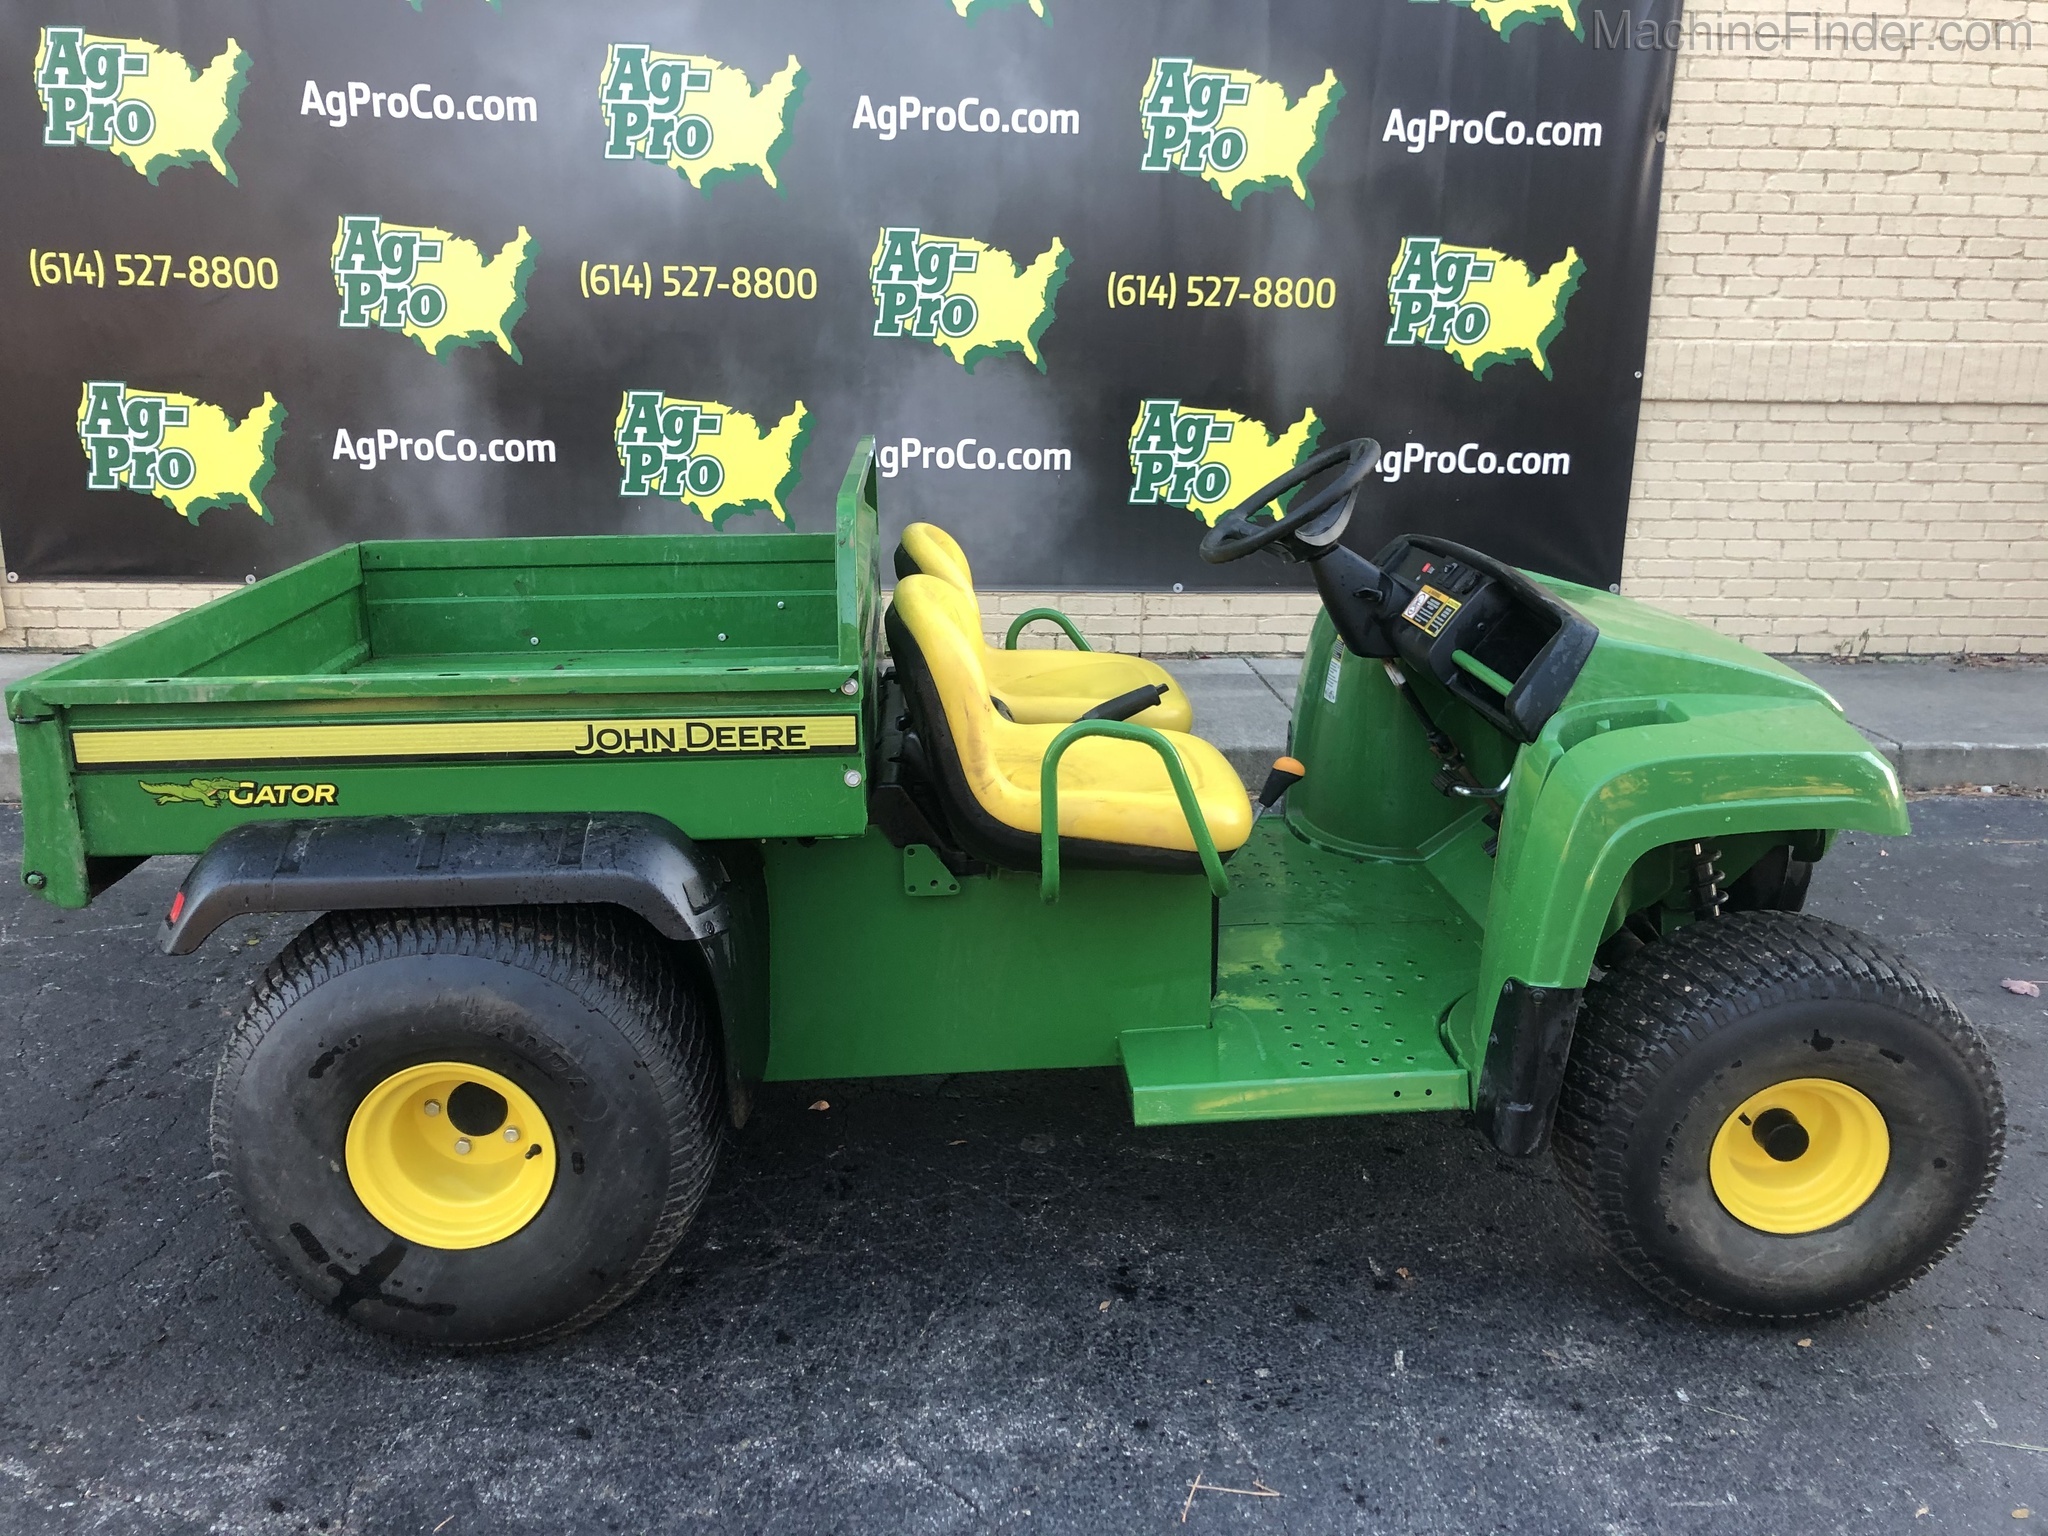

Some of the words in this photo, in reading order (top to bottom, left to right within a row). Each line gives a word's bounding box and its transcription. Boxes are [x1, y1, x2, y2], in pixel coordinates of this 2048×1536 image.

[38, 27, 149, 99] Ag-
[603, 44, 711, 114] Ag-
[43, 86, 155, 145] Pro
[301, 80, 538, 128] AgProCo.com
[852, 95, 1080, 141] AgProCo.com
[1143, 58, 1249, 127] Ag-
[604, 102, 713, 160] Pro
[1141, 115, 1248, 171] Pro
[1382, 108, 1602, 153] AgProCo.com
[29, 248, 105, 289] (614)
[115, 253, 279, 290] 527-8800
[334, 214, 443, 287] Ag-
[875, 227, 979, 297] Ag-
[1391, 237, 1495, 304] Ag-
[339, 272, 447, 328] Pro
[580, 260, 652, 299] (614)
[662, 265, 818, 300] 527-8800
[1107, 271, 1177, 310] (614)
[1187, 276, 1337, 309] 527-8800
[873, 282, 979, 337] Pro
[1387, 293, 1490, 345] Pro
[82, 382, 189, 454] Ag-
[618, 390, 722, 460] Ag-
[1132, 400, 1234, 467] Ag-
[87, 437, 195, 490] Pro
[332, 428, 556, 471] AgProCo.com
[618, 445, 724, 497] Pro
[1129, 452, 1232, 505] Pro
[575, 723, 677, 752] JOHN
[685, 721, 807, 749] DEERE
[228, 782, 338, 807] GATOR
